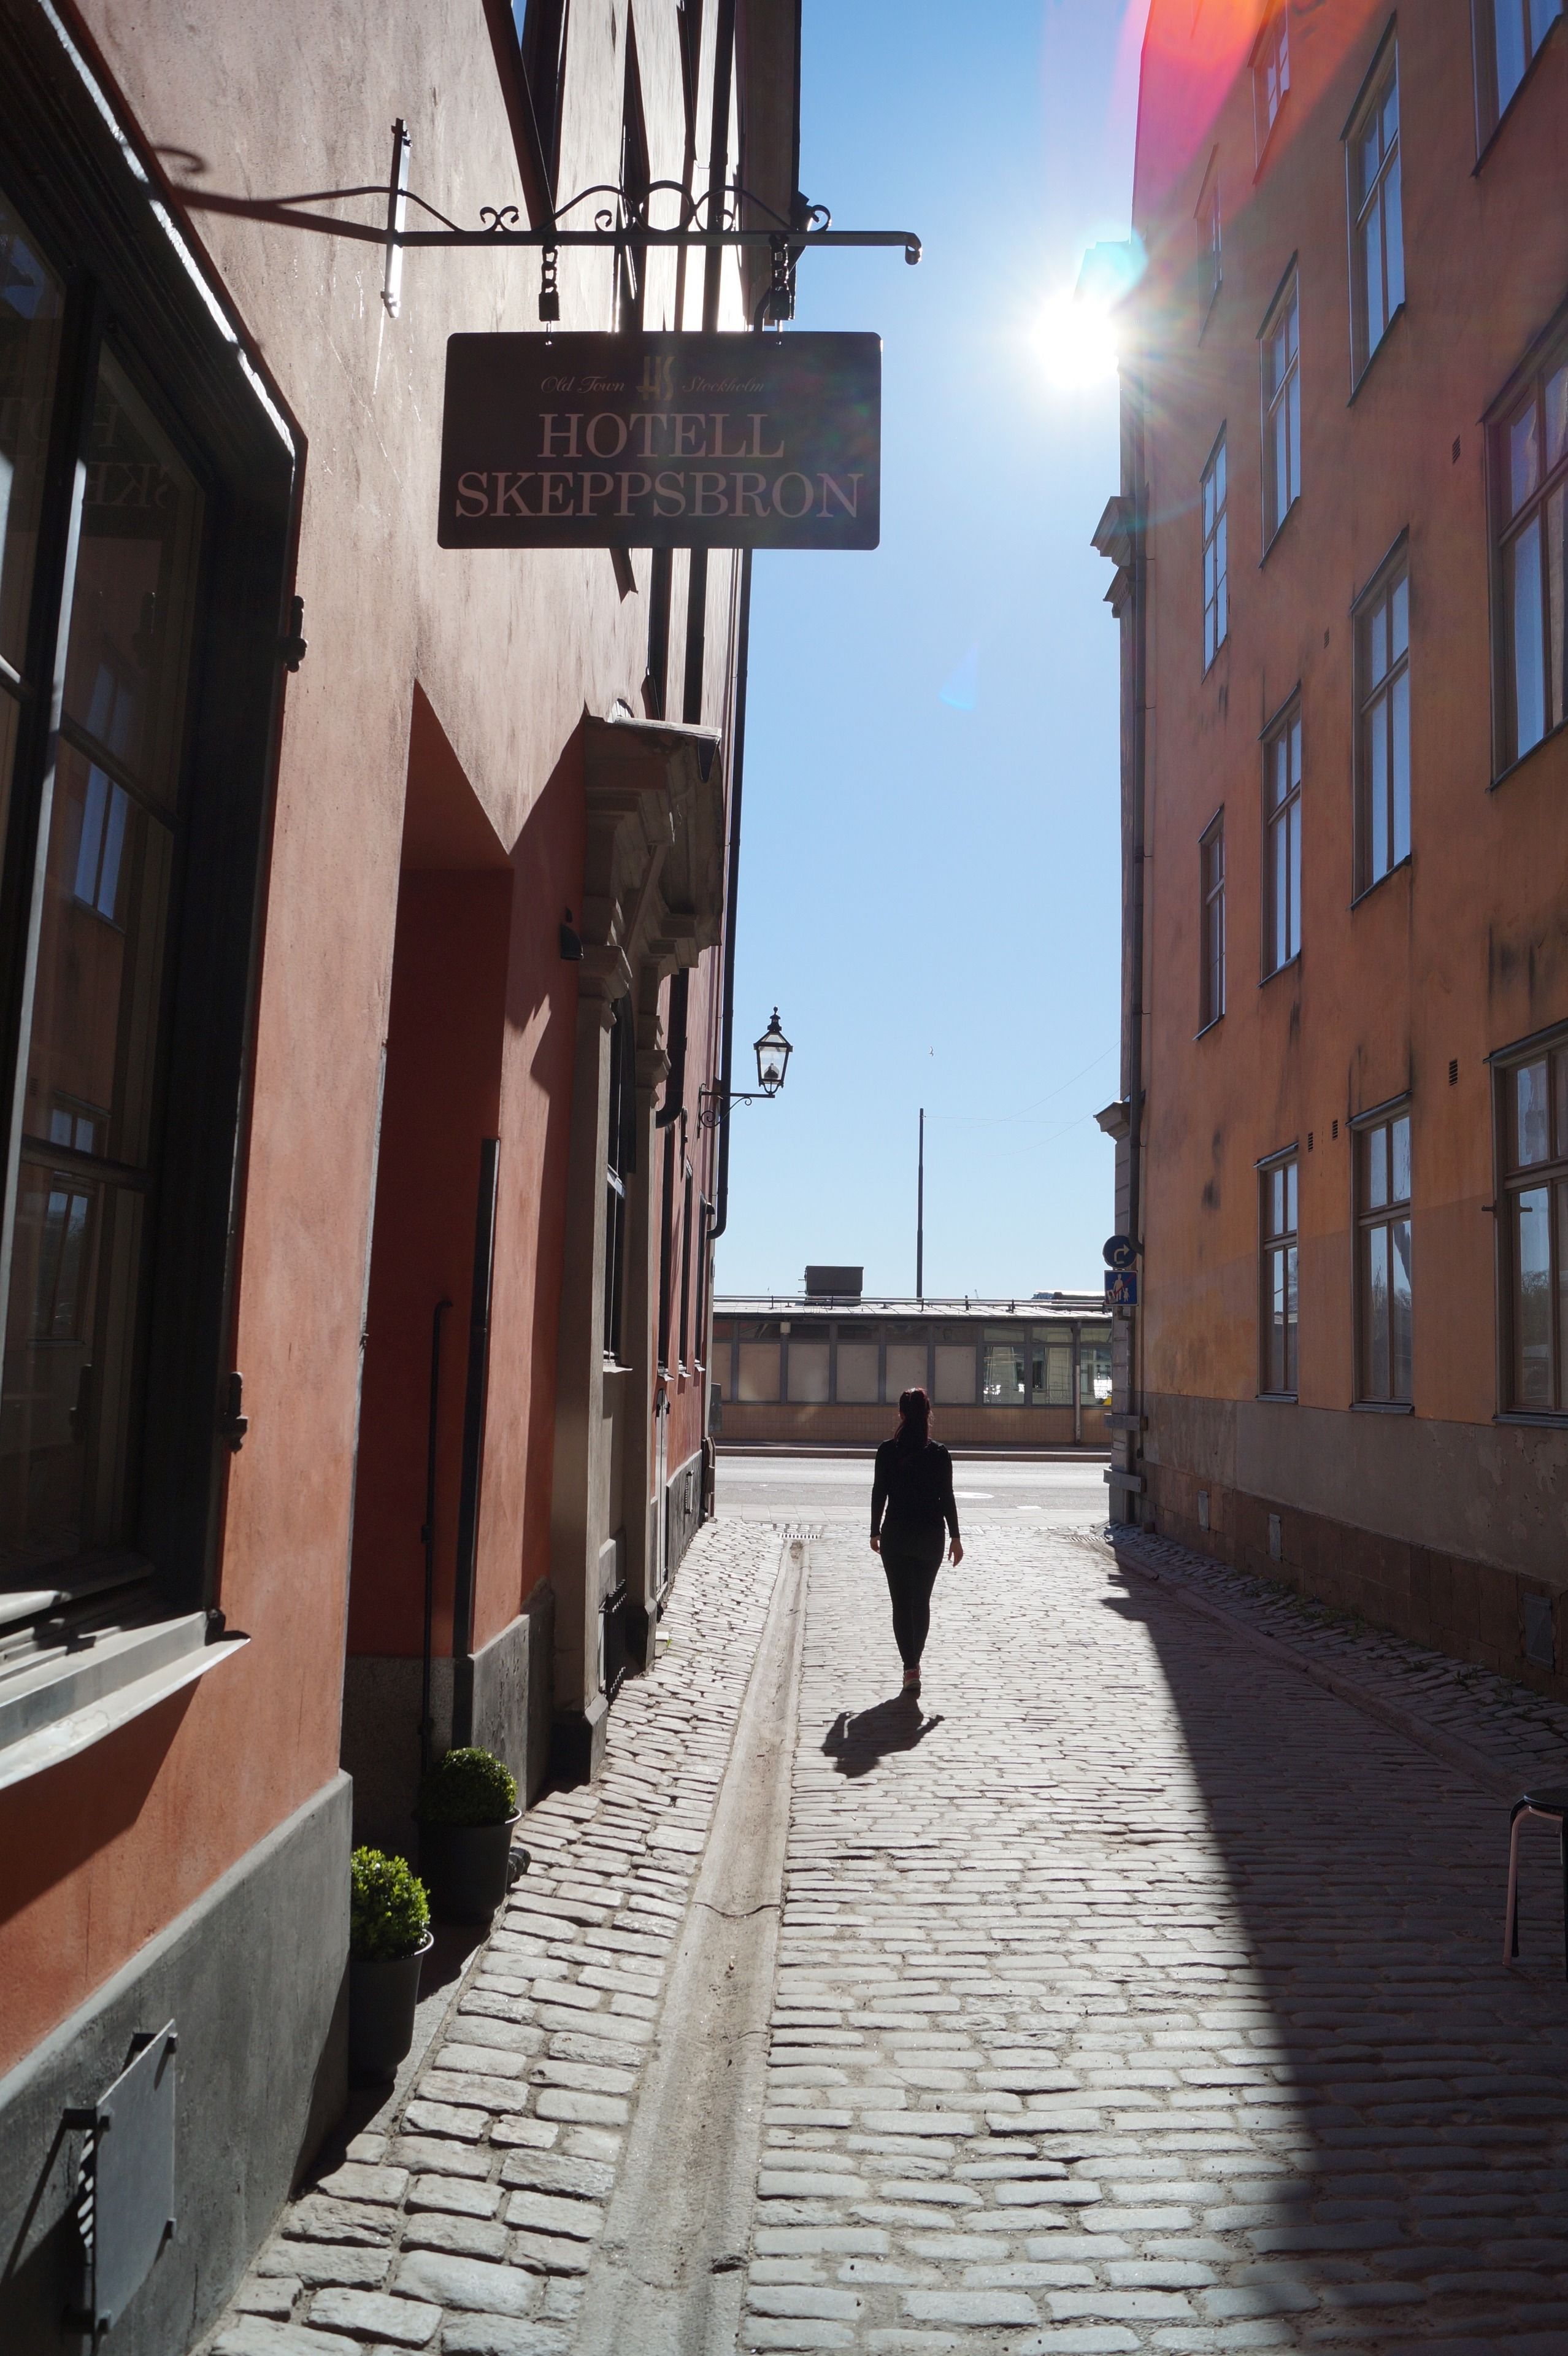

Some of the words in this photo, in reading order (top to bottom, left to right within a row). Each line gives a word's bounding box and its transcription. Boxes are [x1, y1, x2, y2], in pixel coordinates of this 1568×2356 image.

[540, 375, 575, 393] Old
[575, 375, 626, 394] Town
[682, 375, 764, 393] Stockholm
[537, 412, 785, 458] HOTELL
[455, 471, 864, 518] SKEPPSBRON
